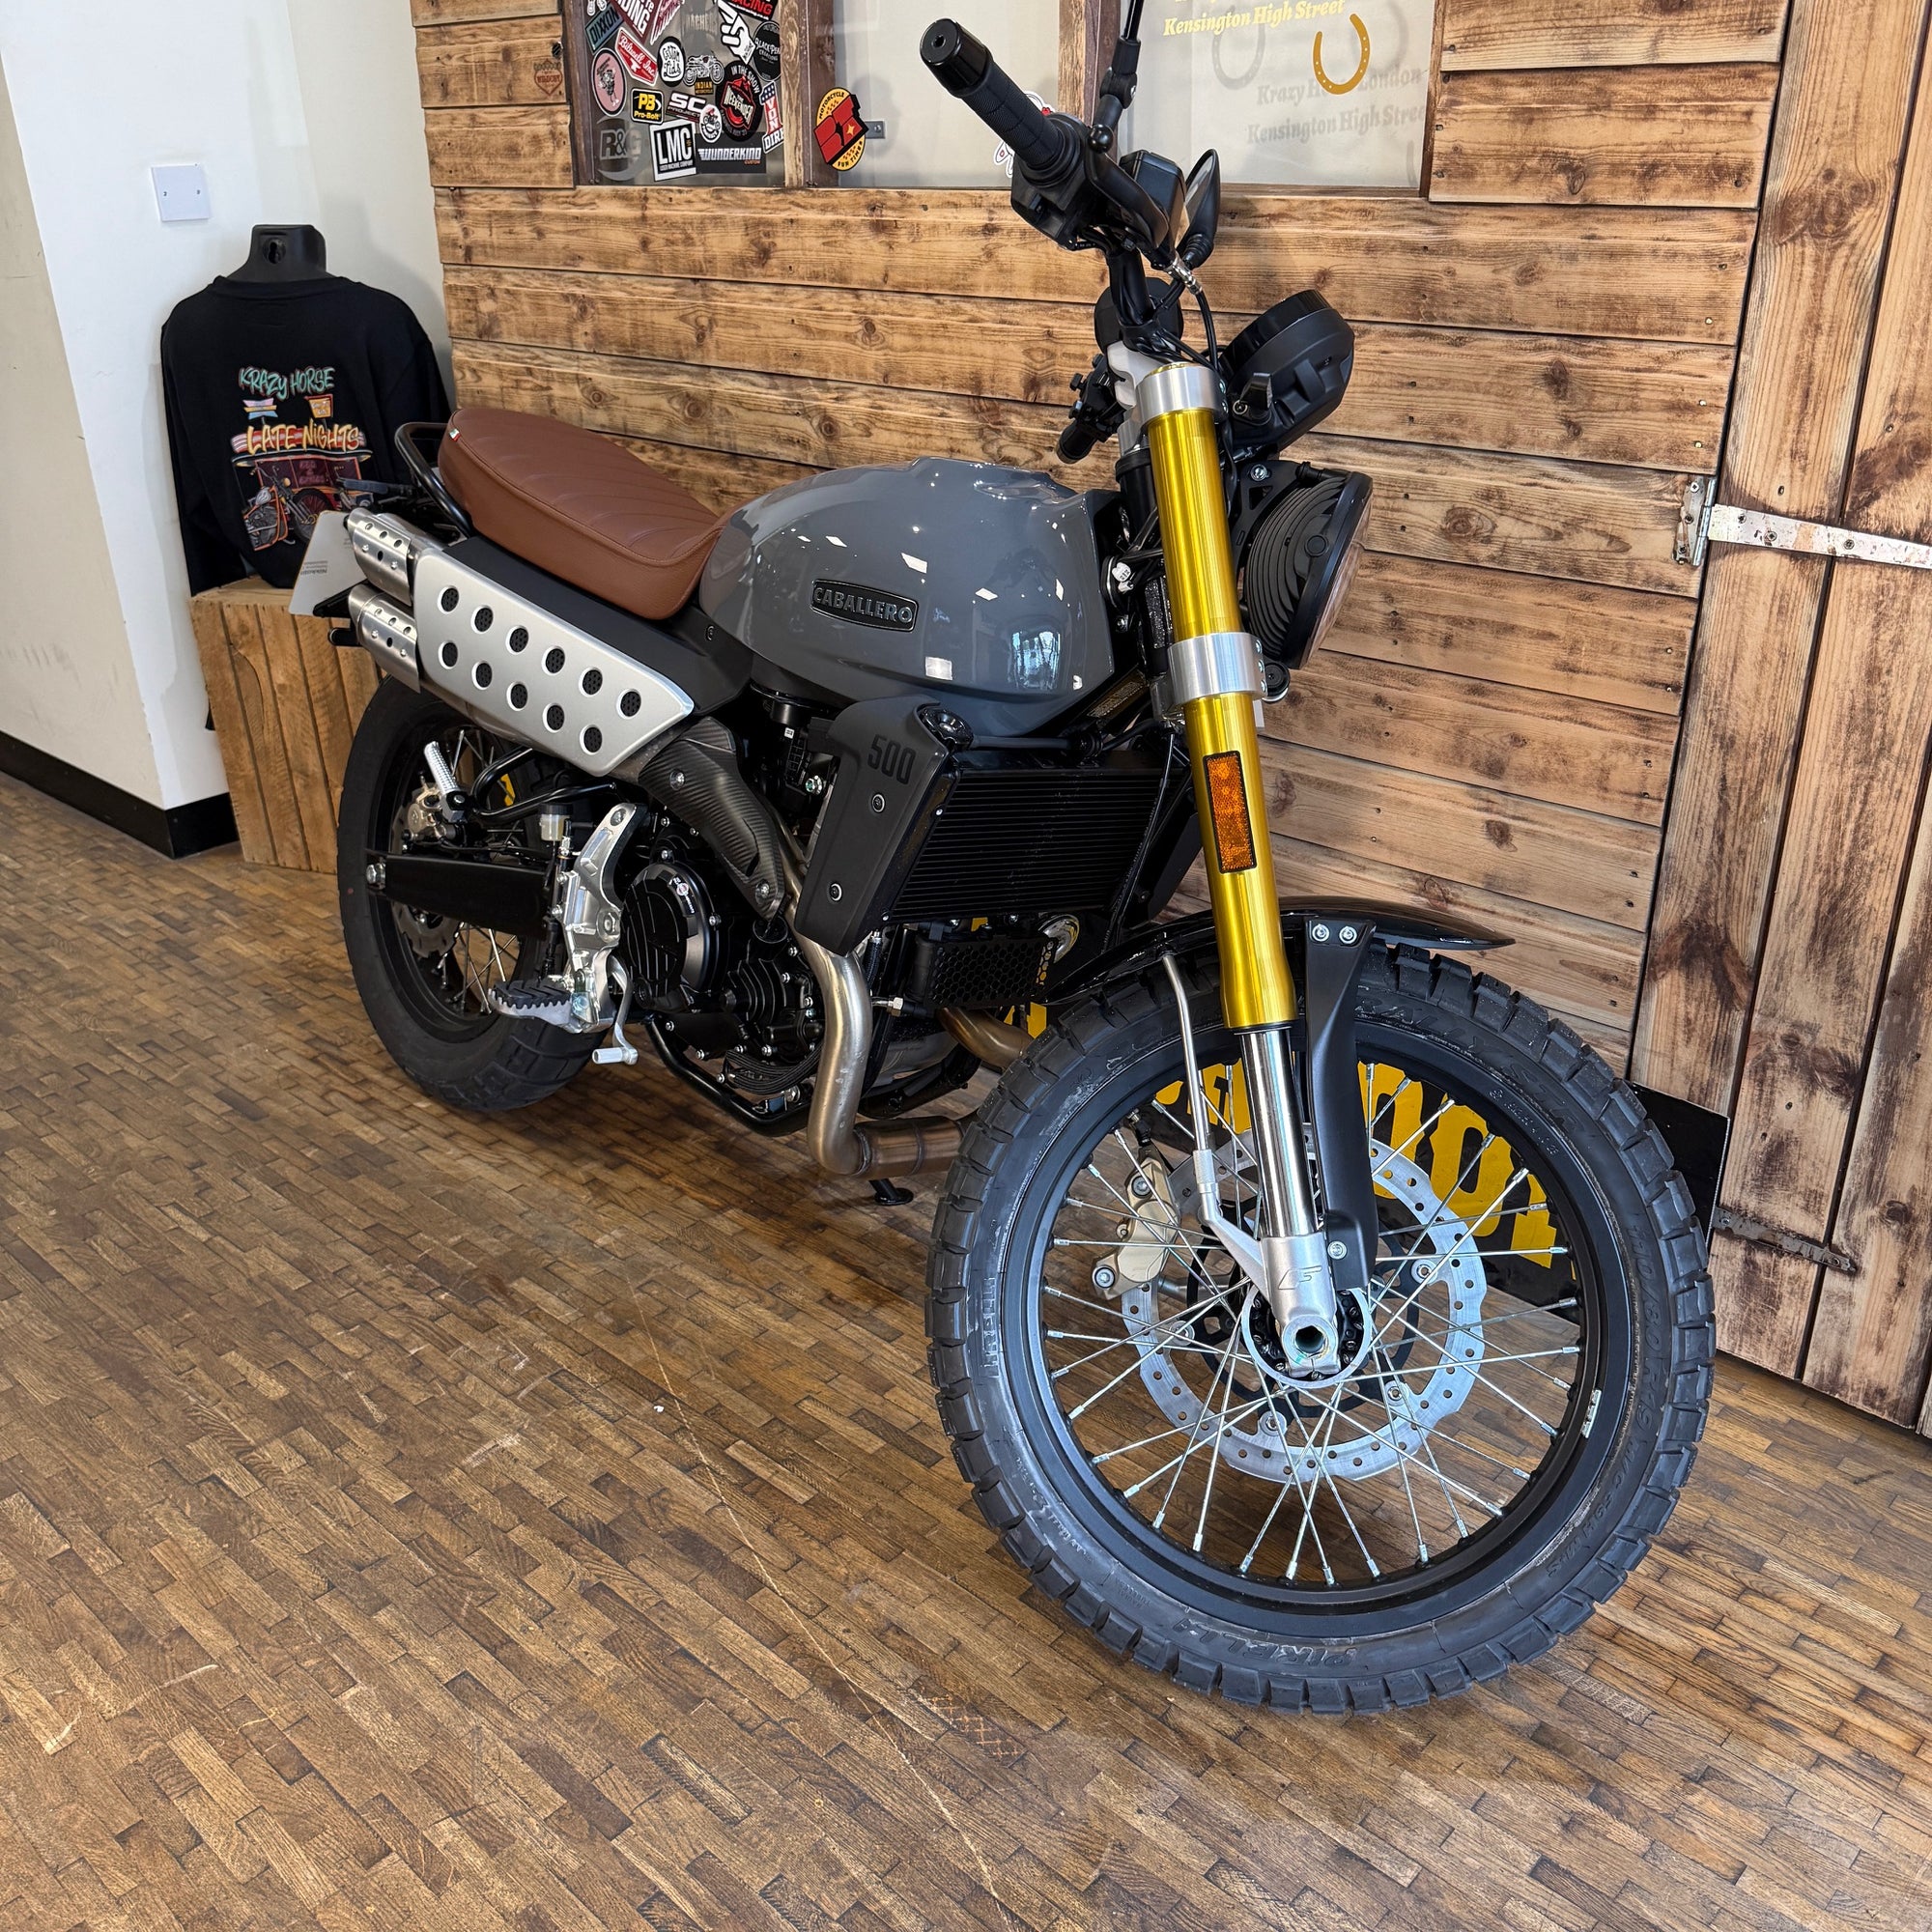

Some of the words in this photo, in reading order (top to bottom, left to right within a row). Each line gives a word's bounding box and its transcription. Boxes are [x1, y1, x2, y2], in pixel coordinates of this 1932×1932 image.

[617, 0, 651, 35] DING
[733, 0, 773, 15] ACING
[1162, 11, 1251, 36] Kensington
[1253, 2, 1293, 28] High
[1294, 0, 1346, 19] Street
[589, 7, 619, 44] DIXXON
[748, 71, 760, 94] SHOW
[1257, 83, 1305, 106] Krazy
[634, 111, 660, 120] Pro-Bolt
[638, 93, 656, 111] PB
[668, 92, 706, 113] SC
[819, 92, 845, 119] MOTORCYCLE
[1248, 119, 1337, 144] Kensington
[1340, 103, 1380, 135] High
[657, 128, 692, 164] LMC
[240, 367, 288, 400] KRAZY
[290, 366, 335, 394] HORSE
[246, 423, 298, 456] LATE
[813, 587, 913, 623] CABALLERO
[867, 733, 917, 785] 500
[1173, 1618, 1358, 1668] PIRELLI
